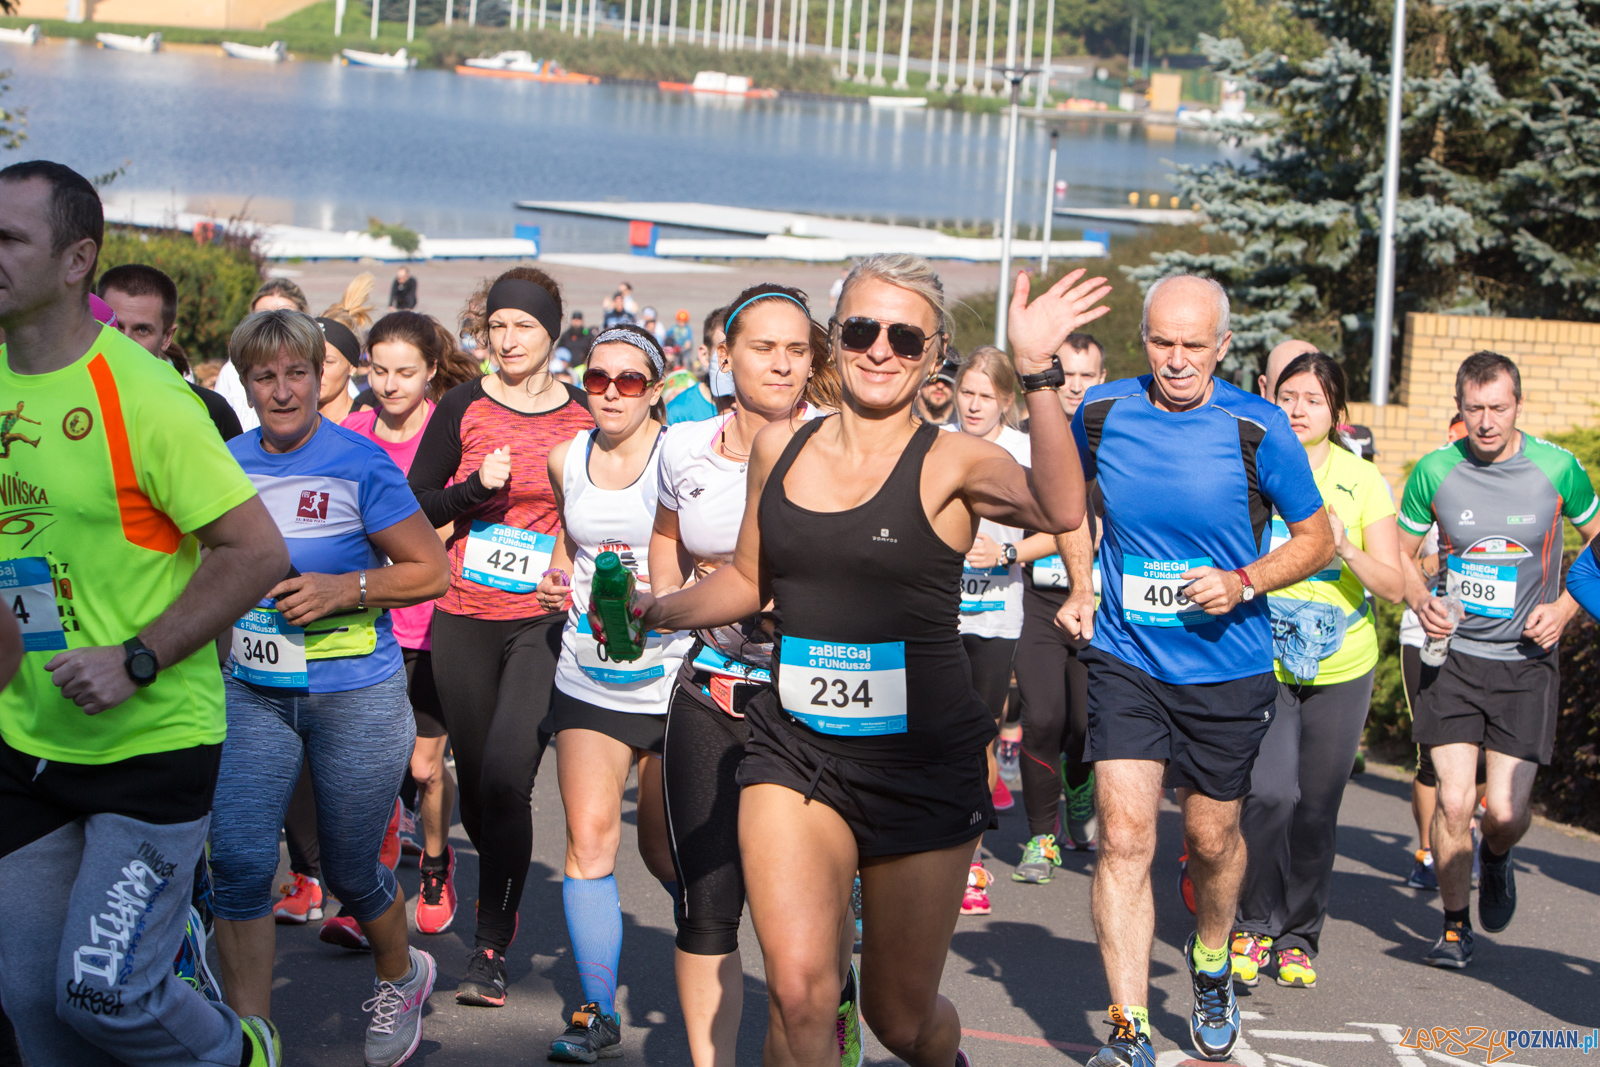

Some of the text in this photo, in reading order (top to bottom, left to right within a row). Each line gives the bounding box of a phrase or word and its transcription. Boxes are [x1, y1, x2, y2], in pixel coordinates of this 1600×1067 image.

[493, 527, 537, 545] zaBIEGaj
[498, 536, 534, 550] FUNdusze
[486, 549, 530, 575] 421
[1144, 560, 1189, 572] zaBIEGaj
[1462, 562, 1498, 576] zaBIEGaj
[1052, 573, 1067, 586] 2
[1461, 580, 1496, 601] 698
[246, 622, 276, 634] FUNdusze
[243, 636, 280, 665] 340
[809, 644, 871, 662] zaBIEGaj
[809, 657, 872, 670] o FUNdusze
[810, 676, 874, 708] 234
